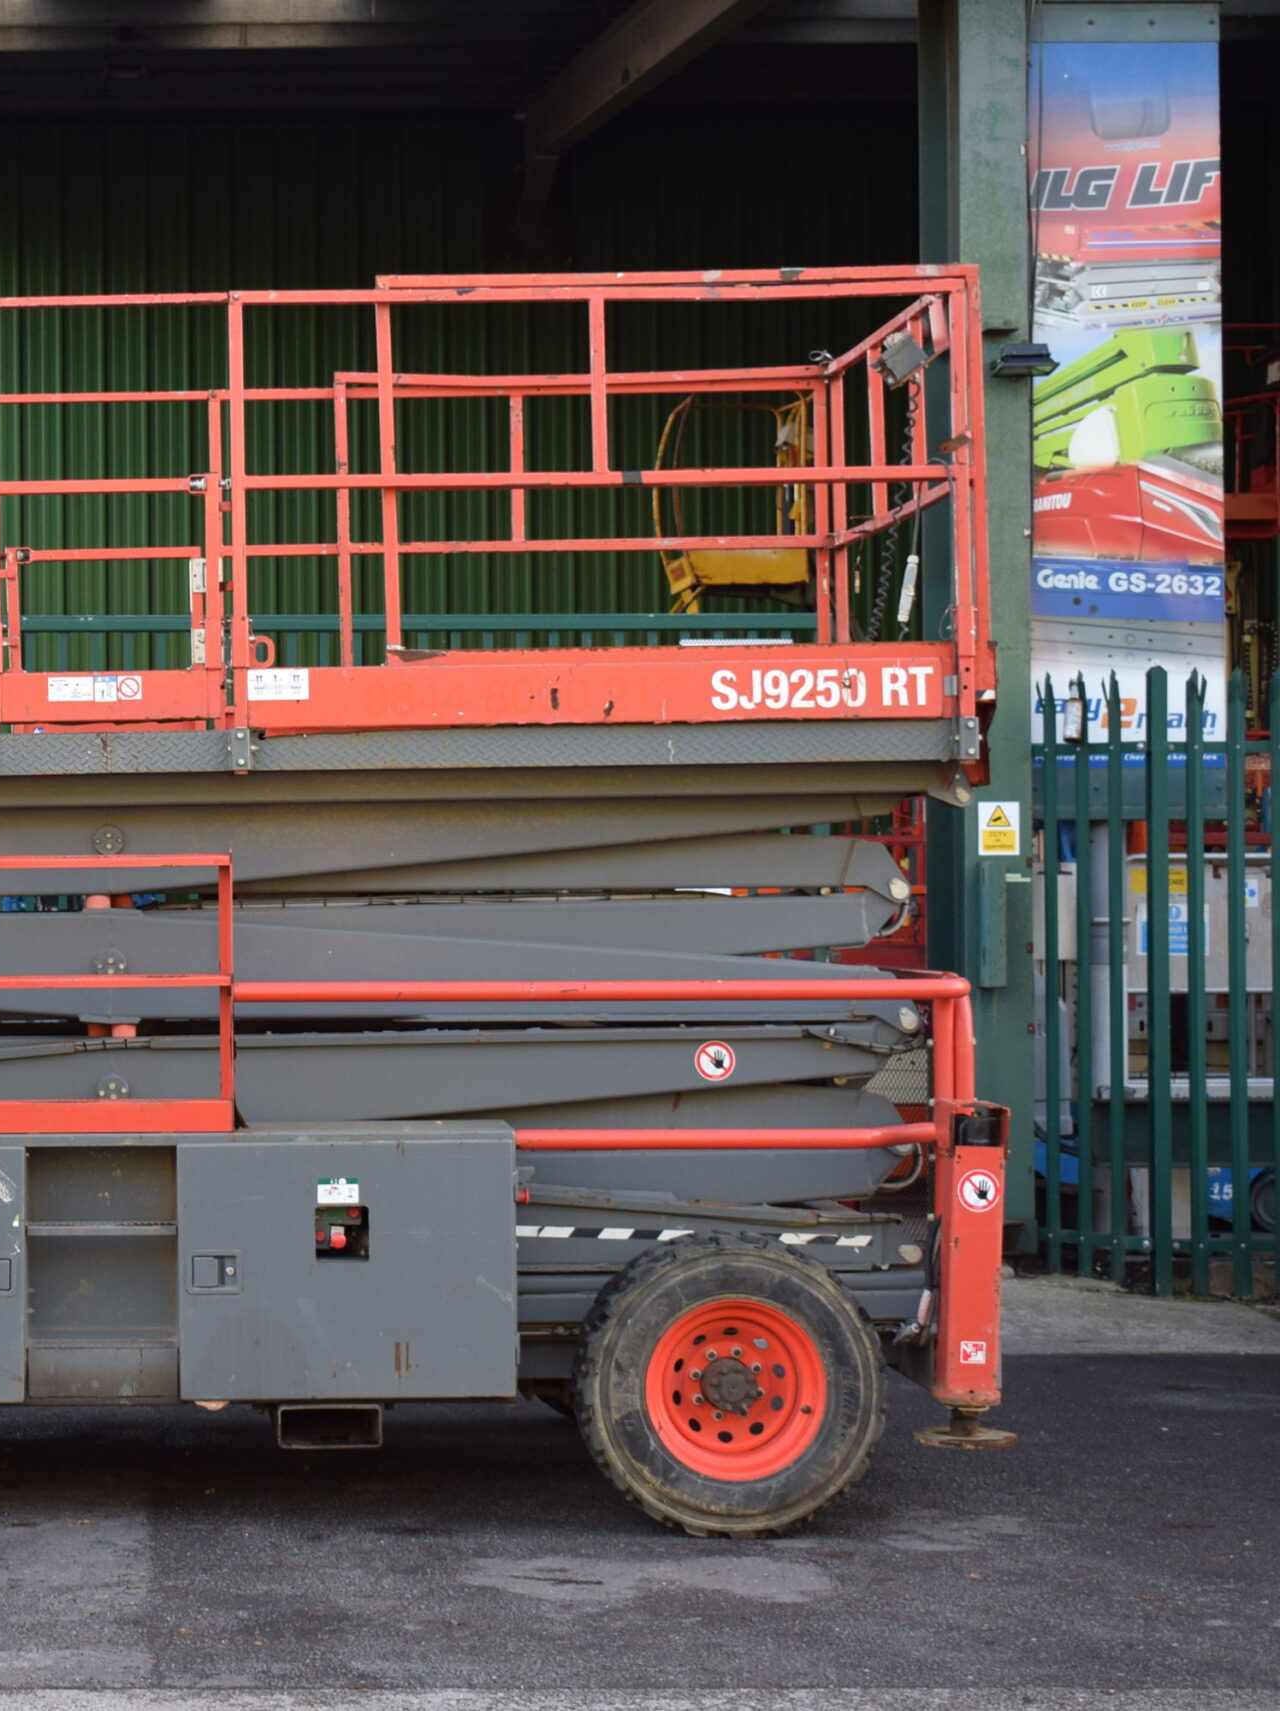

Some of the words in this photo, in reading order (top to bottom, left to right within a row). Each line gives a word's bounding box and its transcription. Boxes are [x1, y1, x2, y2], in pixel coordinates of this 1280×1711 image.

[1037, 569, 1099, 589] Genie
[1108, 571, 1221, 596] GS-2632
[711, 668, 867, 710] SJ9250
[880, 666, 934, 706] RT
